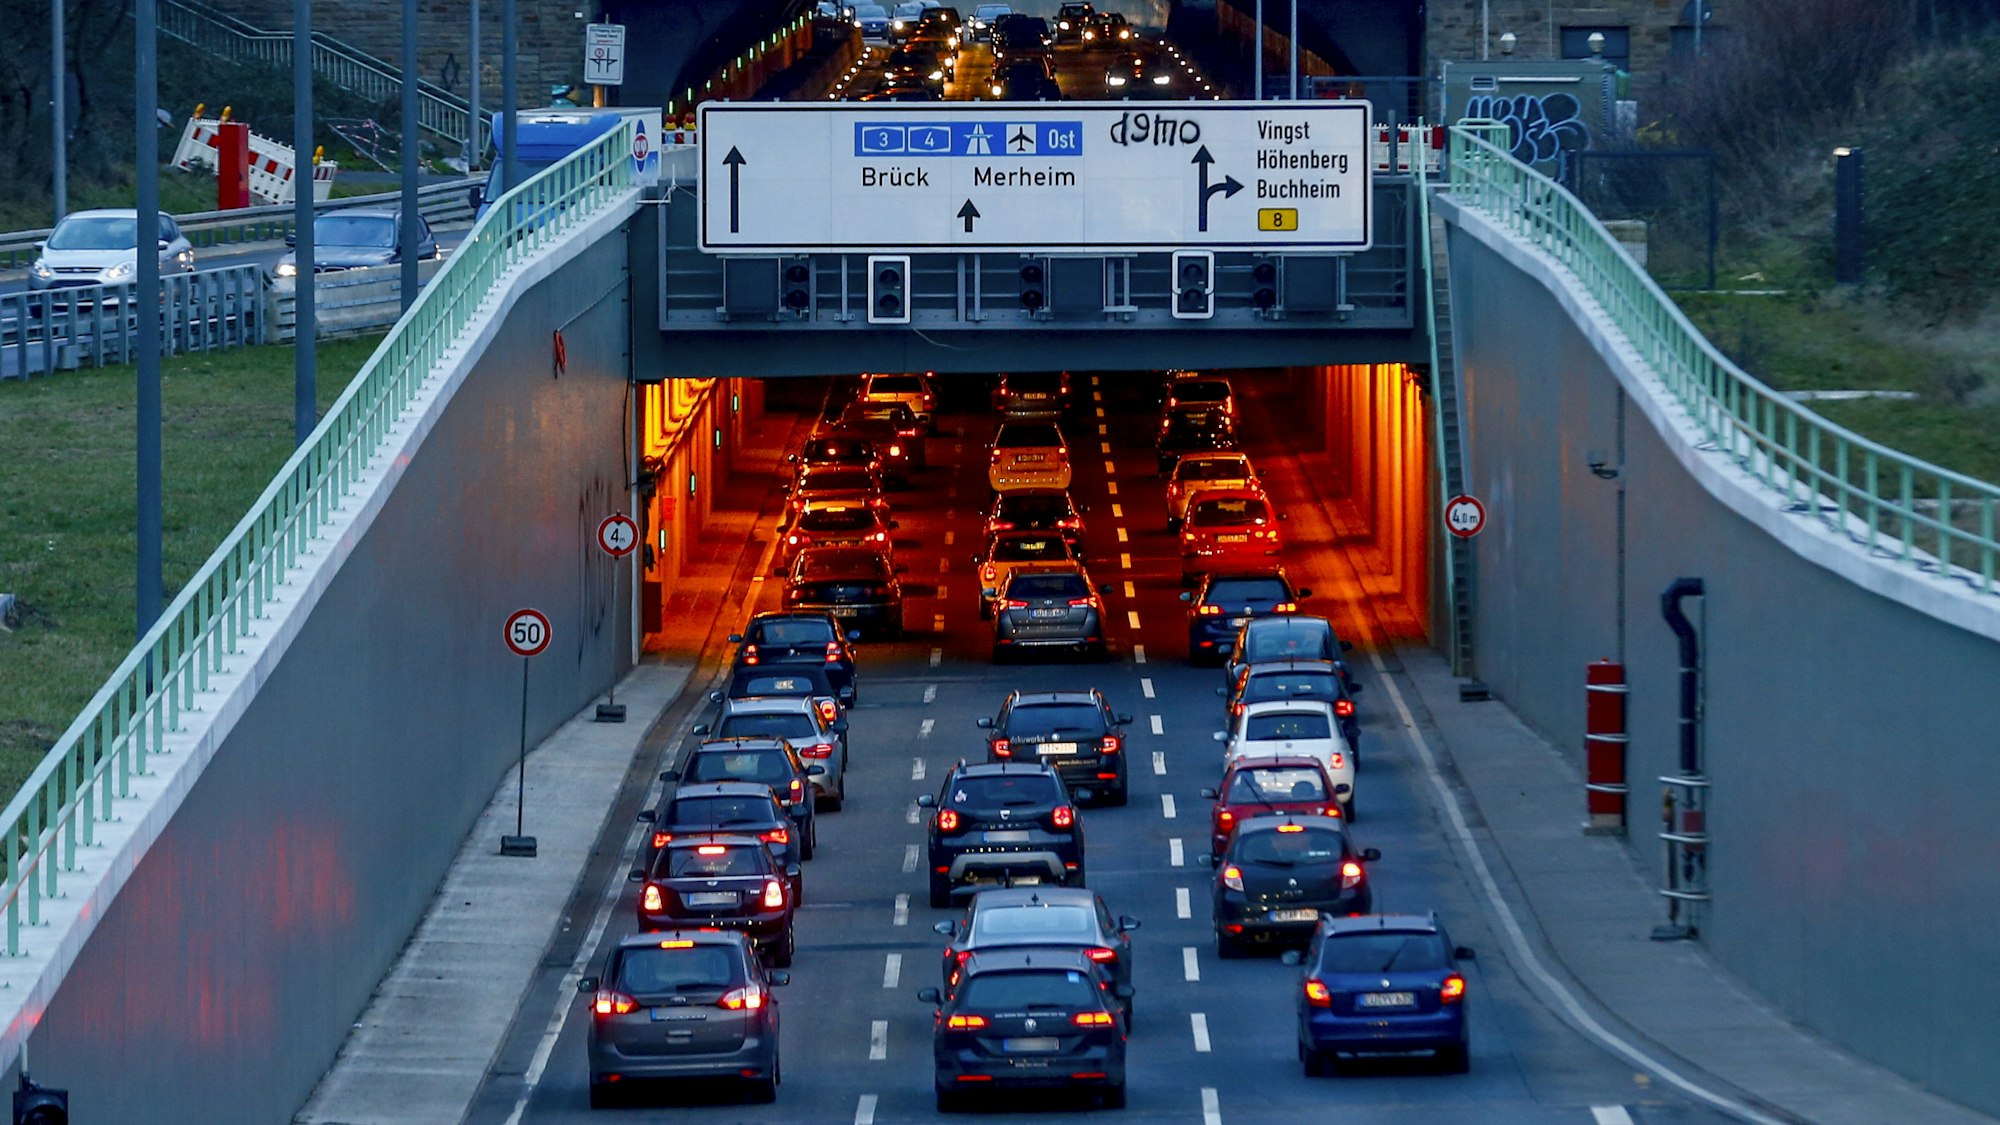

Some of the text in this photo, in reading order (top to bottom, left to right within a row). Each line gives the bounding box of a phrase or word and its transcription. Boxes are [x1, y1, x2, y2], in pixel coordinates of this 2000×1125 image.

[878, 131, 889, 147] 3
[924, 131, 936, 147] 4
[1048, 129, 1076, 149] Ost
[1257, 119, 1310, 145] Vingst
[1257, 149, 1348, 175] Höhenberg
[862, 166, 930, 187] Brück
[974, 166, 1076, 187] Merheim
[1257, 178, 1340, 199] Buchheim
[1273, 212, 1283, 228] 8
[514, 622, 541, 645] 50
